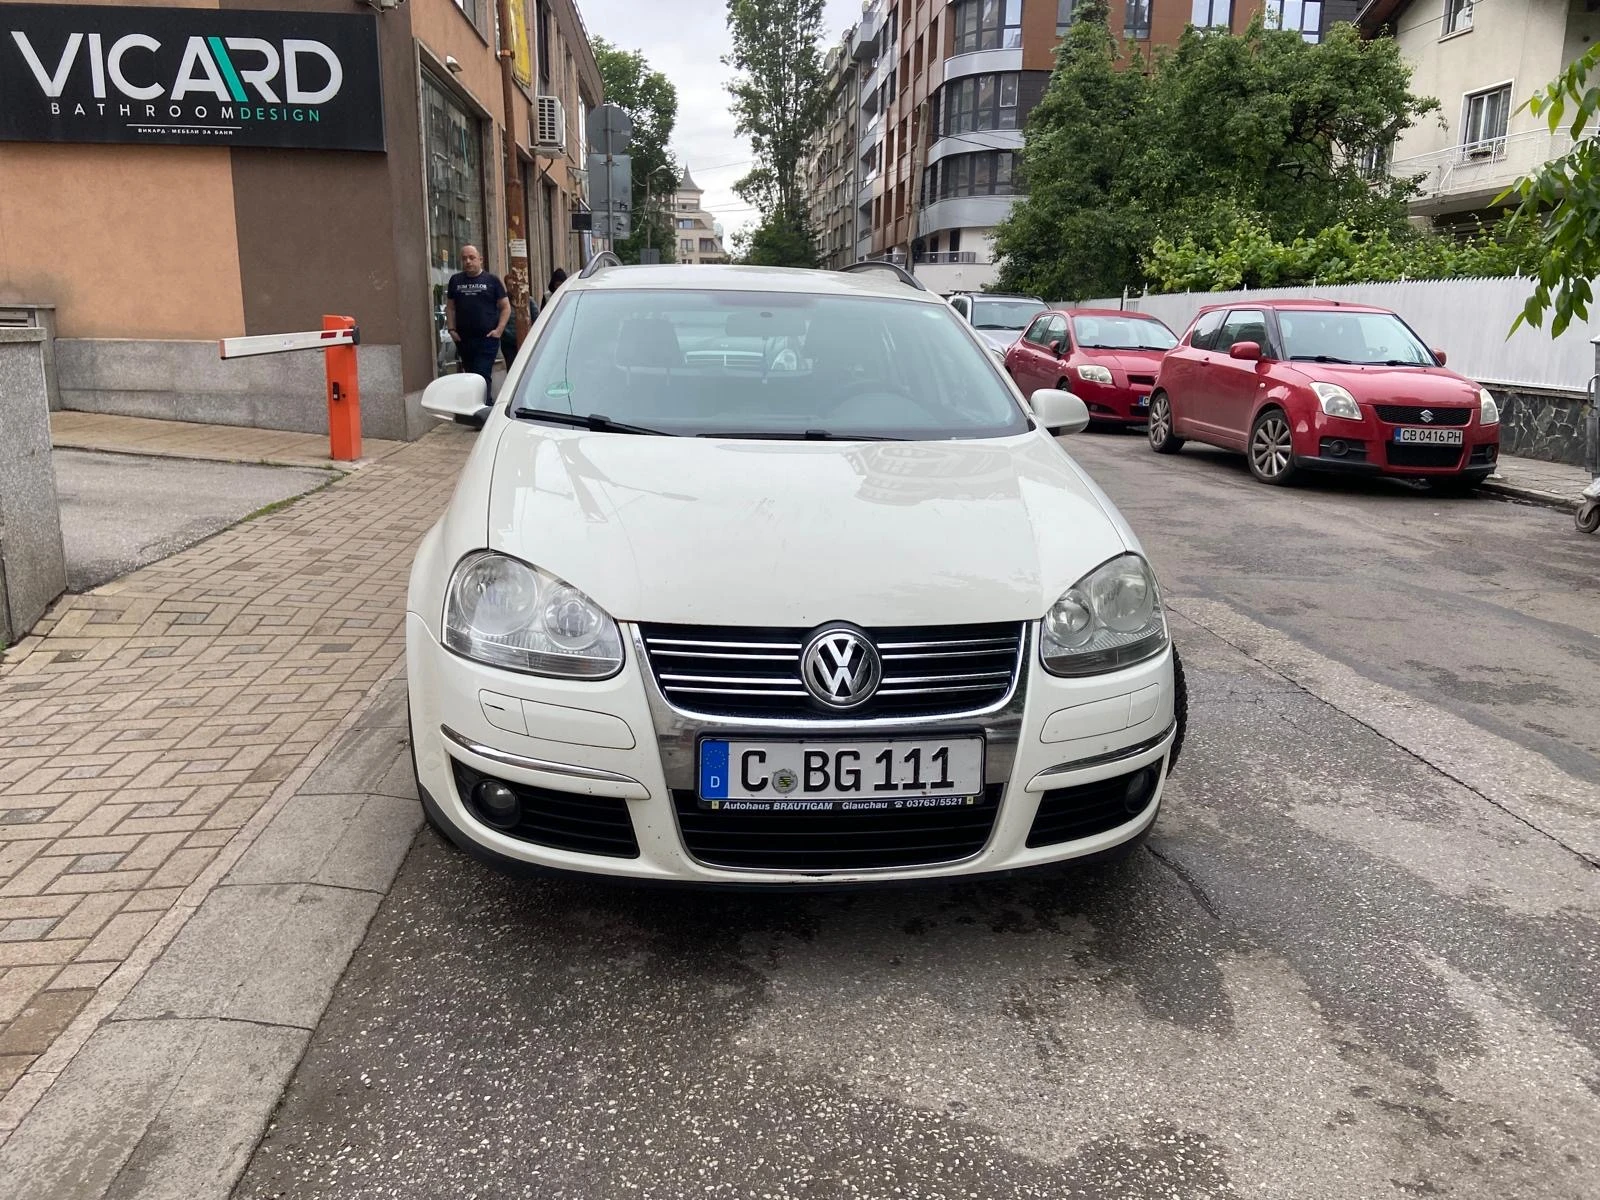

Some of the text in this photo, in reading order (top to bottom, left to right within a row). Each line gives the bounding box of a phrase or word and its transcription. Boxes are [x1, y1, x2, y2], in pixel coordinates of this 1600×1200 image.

[10, 31, 343, 105] VICARD
[51, 102, 321, 123] BATHROOM DESIGN
[1419, 430, 1445, 442] 0416
[803, 749, 863, 793] BG
[873, 745, 955, 792] 111
[710, 775, 721, 788] D
[723, 797, 963, 811] Autohaus BRÄUTIGAM Glauchau 03763/5521
